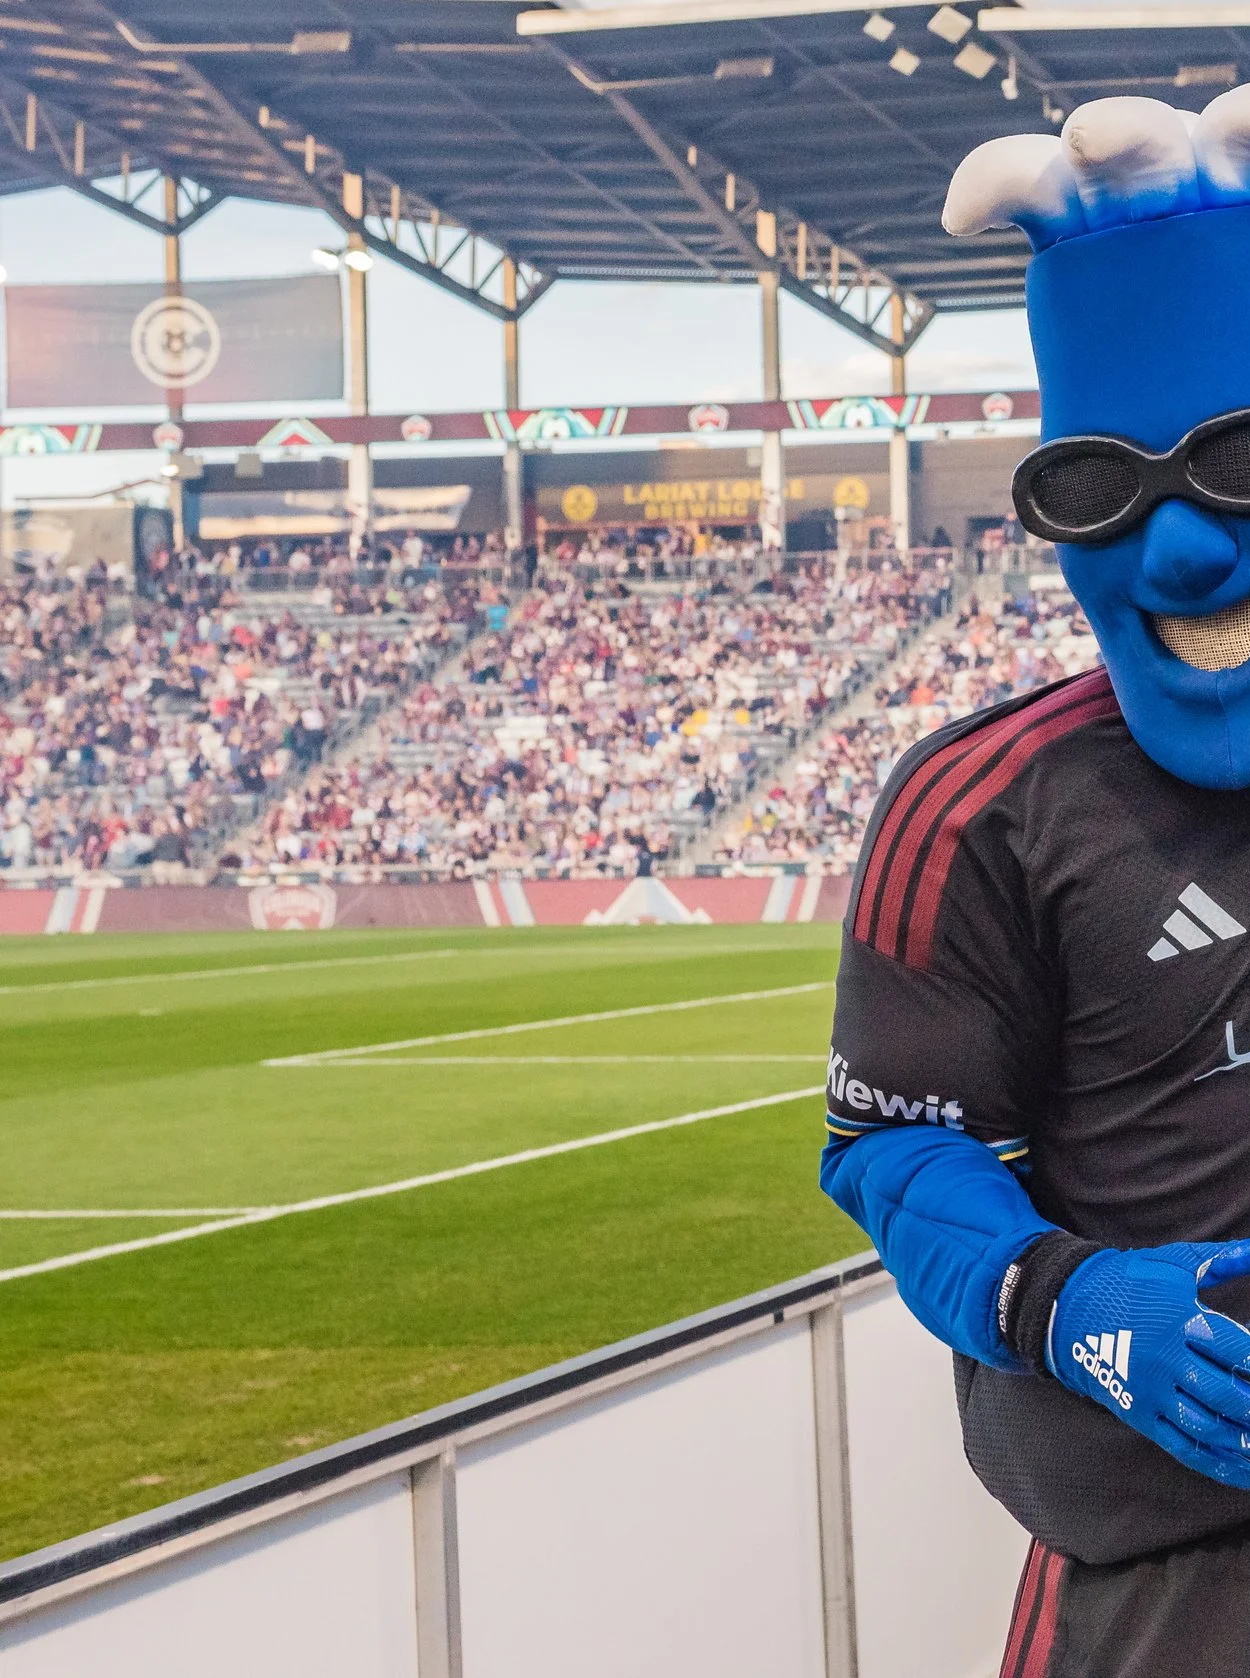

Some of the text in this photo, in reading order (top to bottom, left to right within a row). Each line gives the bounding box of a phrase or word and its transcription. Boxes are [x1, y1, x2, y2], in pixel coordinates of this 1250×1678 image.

[644, 502, 748, 519] BREWING
[827, 1046, 964, 1131] Kiewit
[1072, 1342, 1133, 1410] adidas
